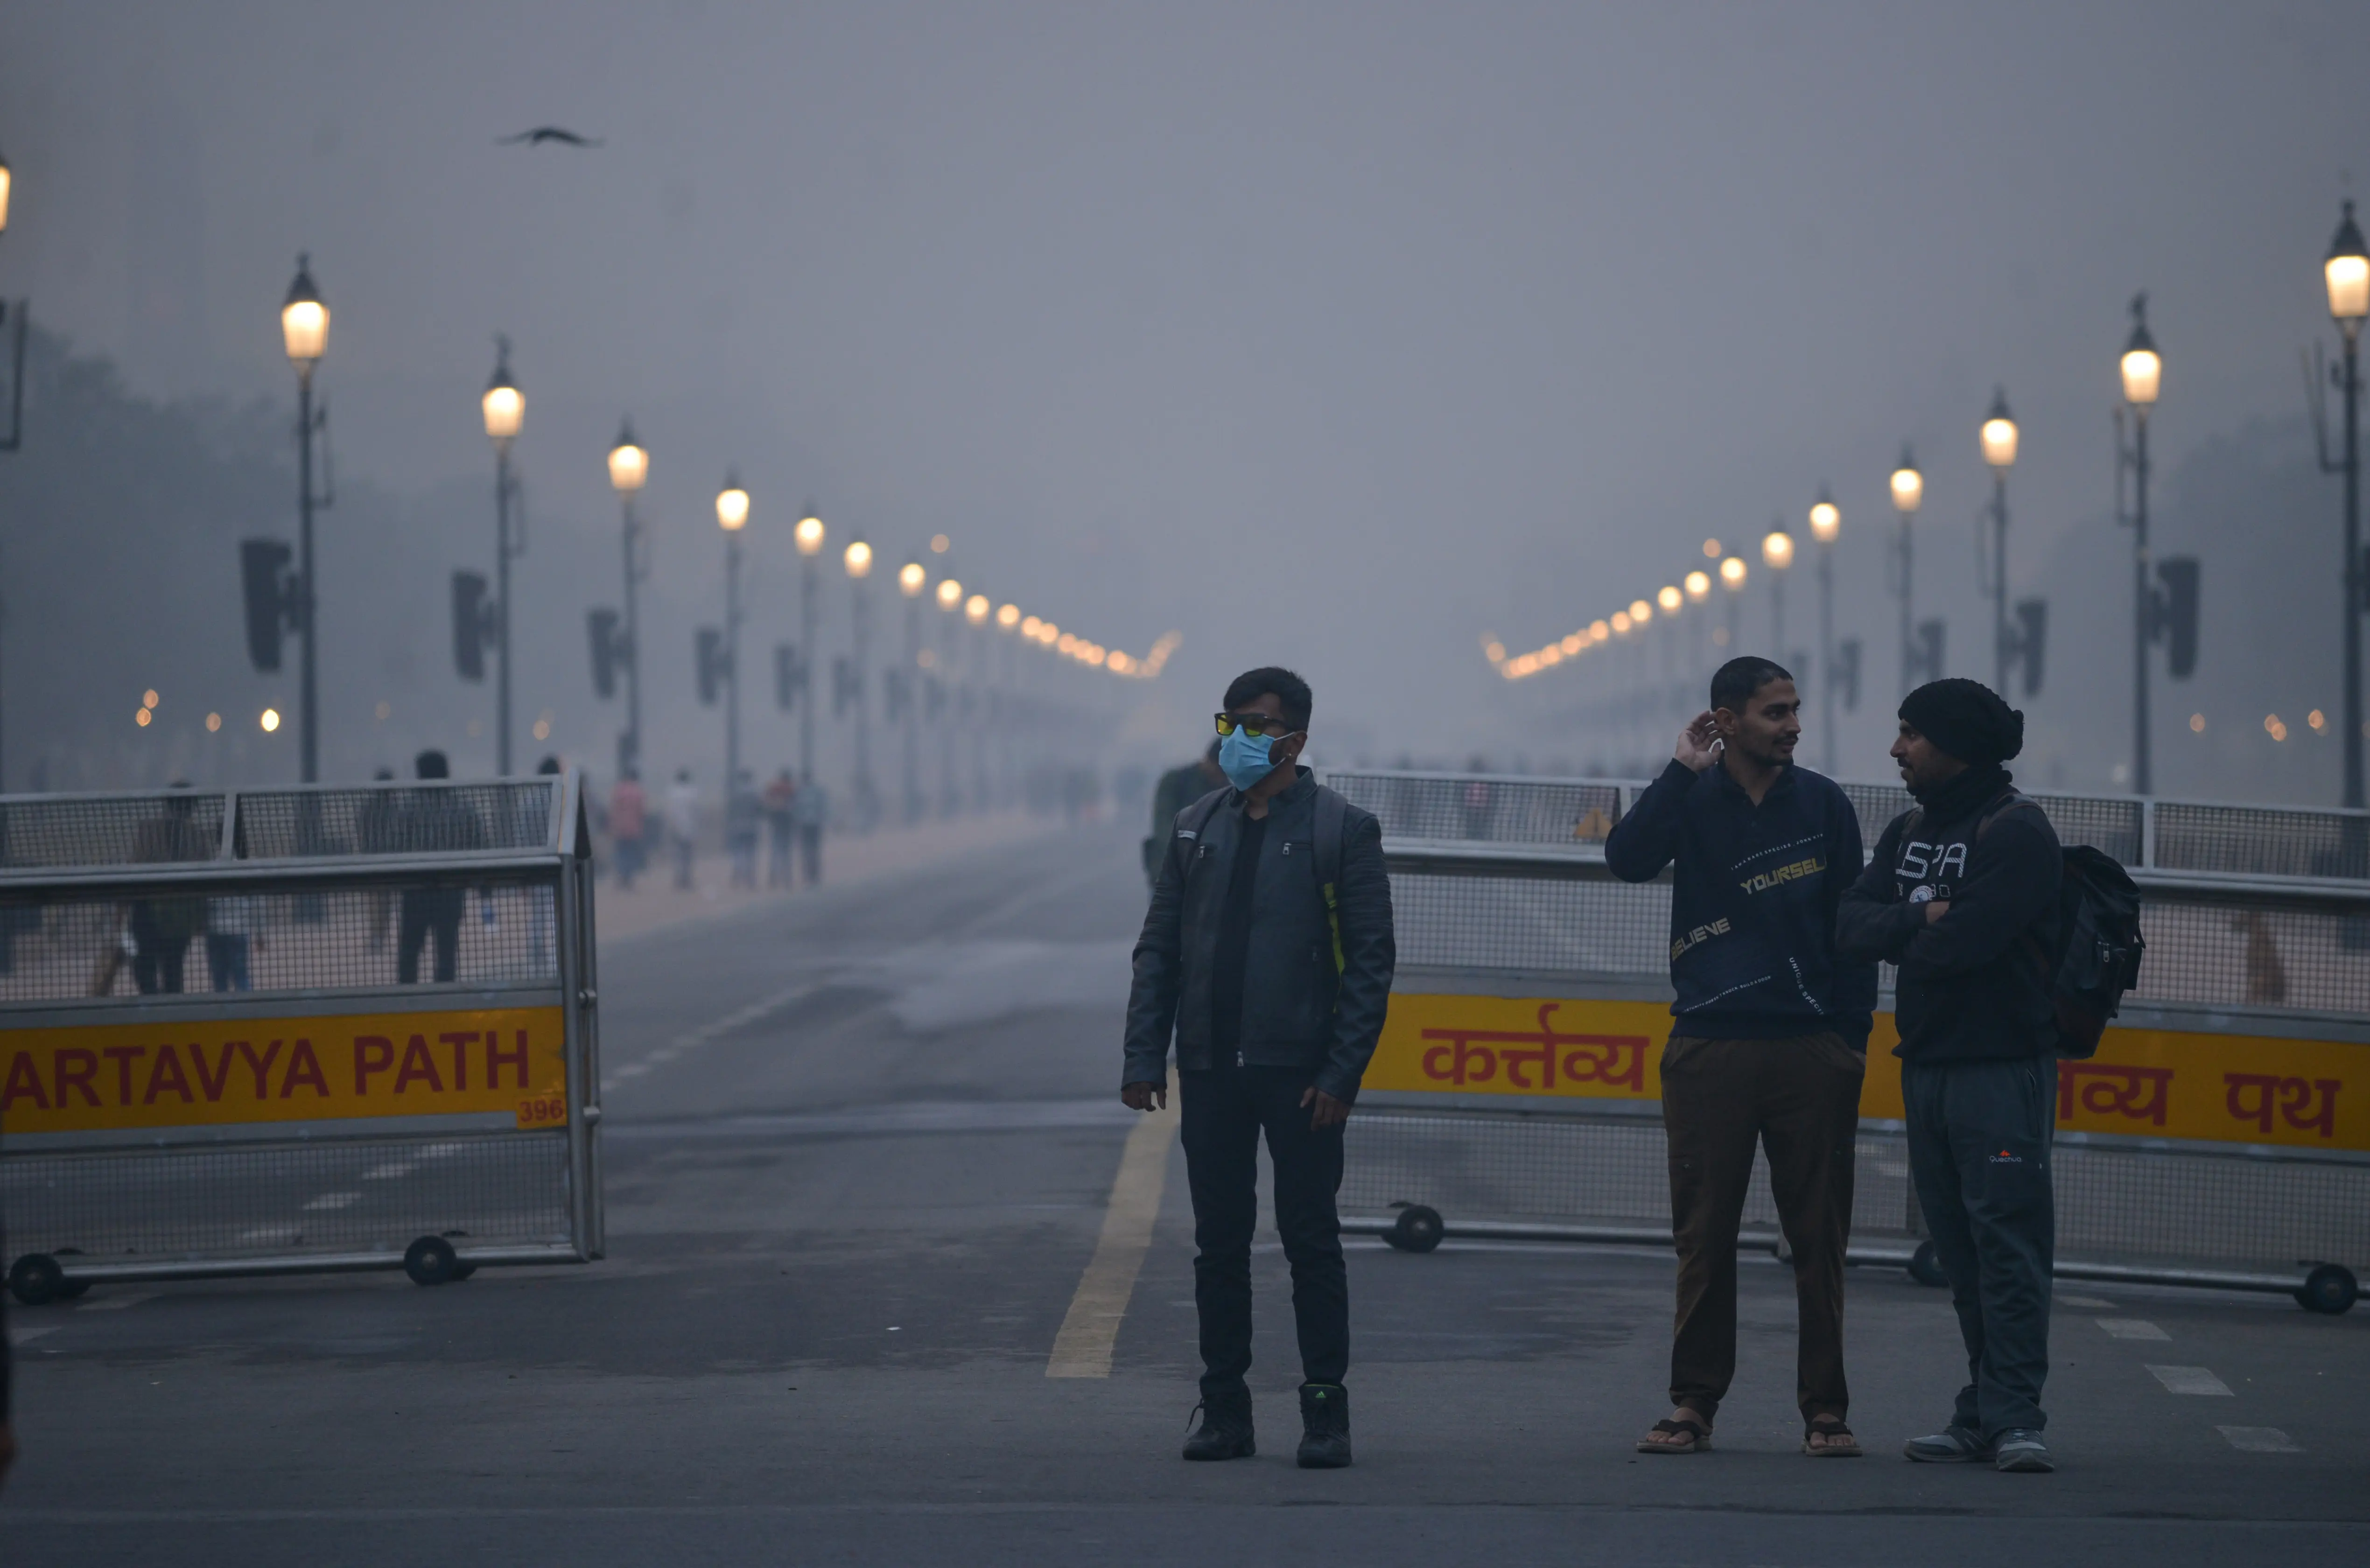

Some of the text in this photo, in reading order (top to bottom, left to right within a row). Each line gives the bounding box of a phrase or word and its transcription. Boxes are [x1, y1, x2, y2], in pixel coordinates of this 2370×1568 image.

[1740, 858, 1827, 895] YOURSEL
[1670, 917, 1731, 962] BELIEVE
[1789, 956, 1804, 990] UNIQUE
[1, 1029, 529, 1112] ARTAVYA PATH
[519, 1099, 563, 1122] 396
[2224, 1073, 2342, 1138] पथ
